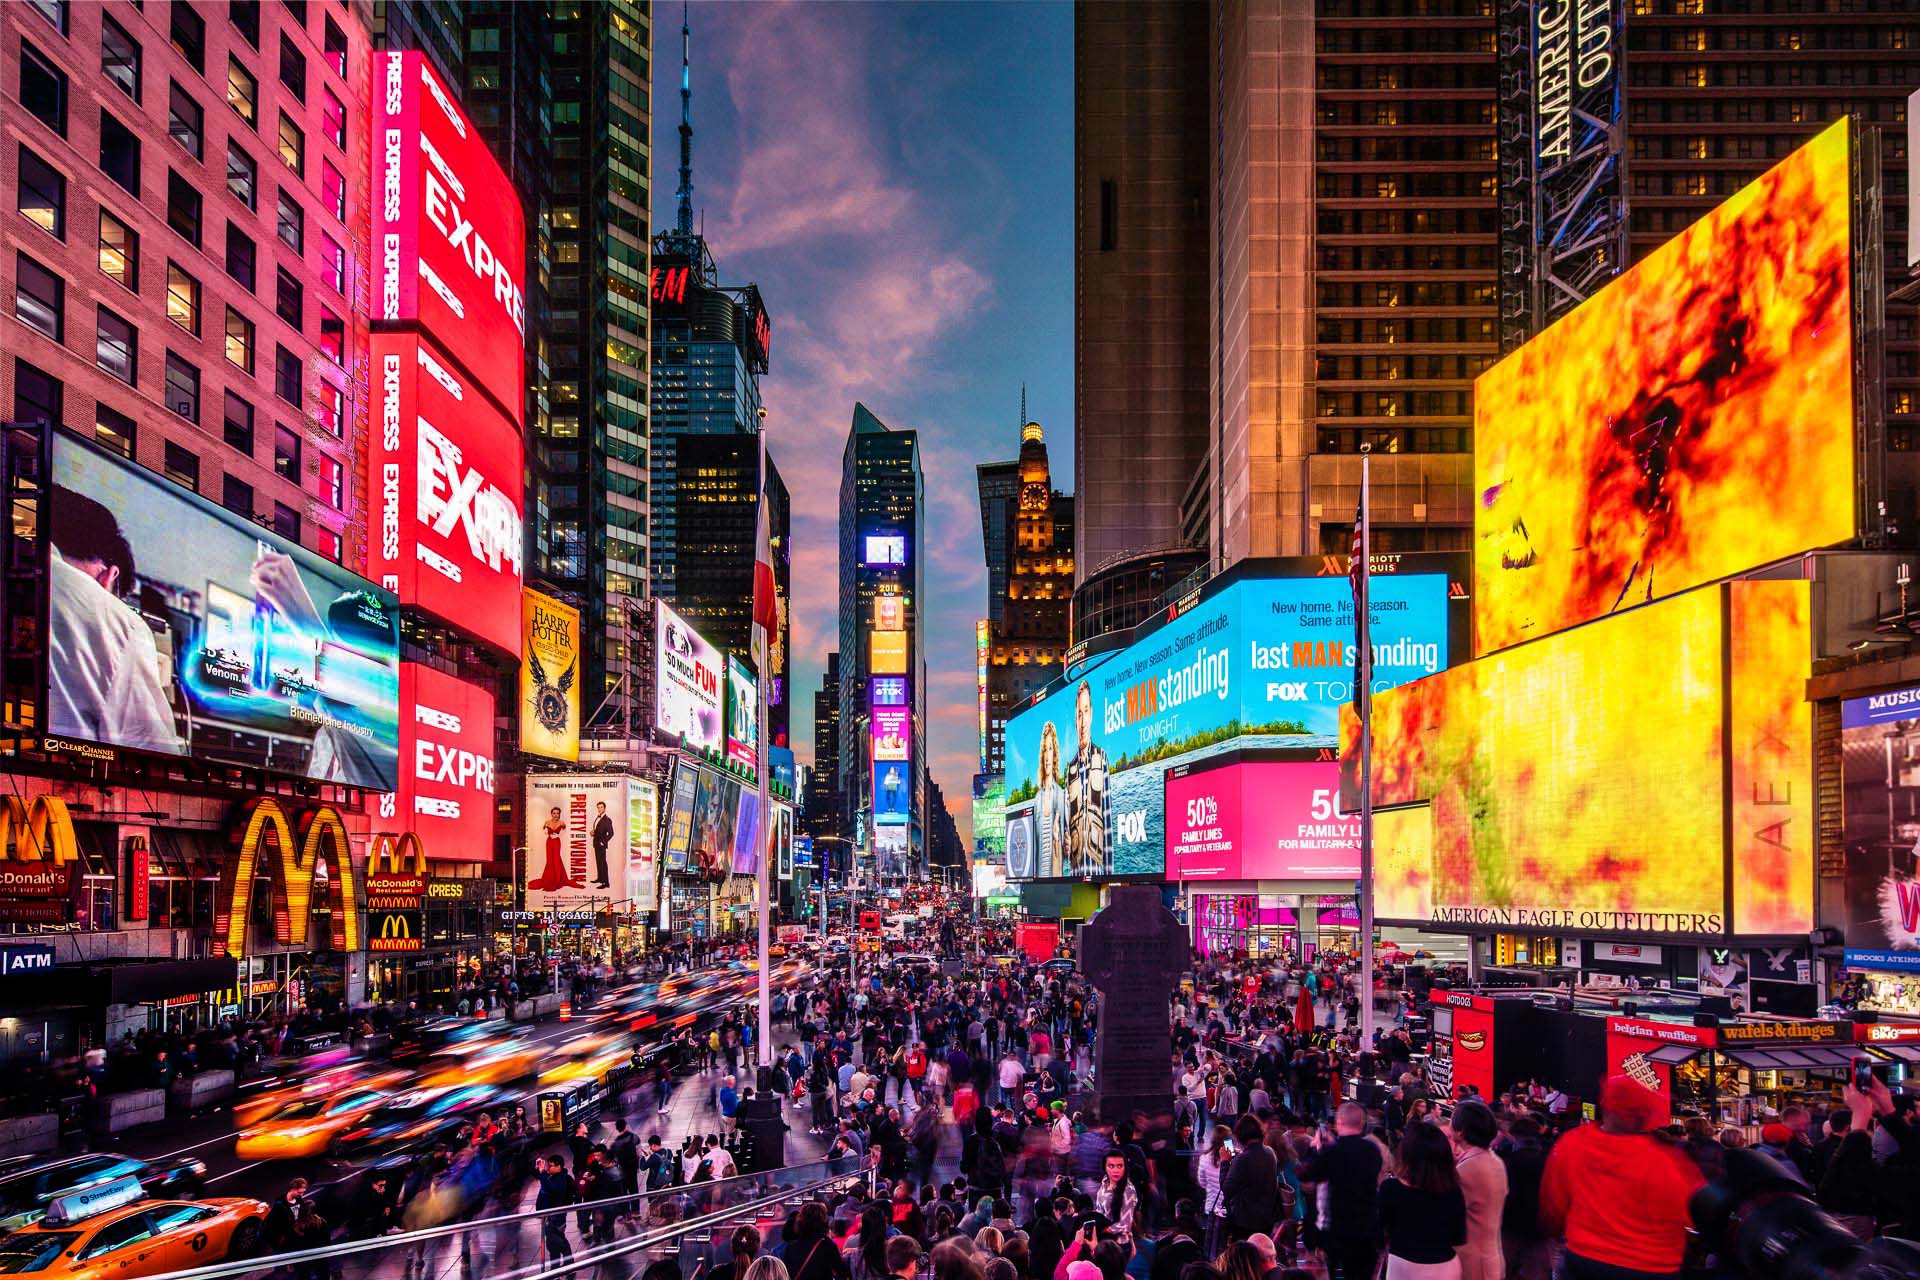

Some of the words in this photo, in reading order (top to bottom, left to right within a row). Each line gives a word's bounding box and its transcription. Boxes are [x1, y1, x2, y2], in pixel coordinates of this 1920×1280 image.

[384, 129, 402, 223] EXPRESS
[383, 354, 400, 452] EXPRESS
[382, 463, 400, 561] EXPRESS
[1272, 601, 1297, 614] New
[1300, 600, 1334, 613] home.
[1338, 600, 1354, 612] Ne
[533, 605, 571, 636] HARRY
[1299, 614, 1332, 627] Same
[1335, 613, 1381, 626] attide.
[531, 619, 573, 651] POTTER
[1251, 640, 1290, 670] last
[1292, 640, 1343, 669] MAN
[695, 660, 718, 698] FUN
[1104, 691, 1126, 736] last
[1126, 675, 1158, 727] MAN
[1158, 646, 1229, 713] standing
[1266, 682, 1309, 702] FOX
[1138, 713, 1179, 743] TONIGHT
[570, 793, 587, 833] PRETTY
[1206, 813, 1218, 826] OFF
[1117, 809, 1148, 845] FOX
[1181, 829, 1204, 844] FAMILY
[1203, 827, 1223, 841] LINES
[1297, 824, 1348, 838] FAMILY
[1278, 839, 1299, 849] FOR
[570, 839, 587, 883] WOMAN
[366, 879, 423, 889] McDonald's
[501, 911, 535, 920] GIFTS
[1430, 907, 1513, 926] AMERICAN
[1517, 909, 1575, 928] EAGLE
[1580, 911, 1722, 935] OUTFITTERS
[11, 953, 51, 969] ATM
[1614, 1022, 1654, 1037] belgian
[1657, 1029, 1697, 1042] waffles
[1724, 1023, 1836, 1041] wafels&dinges
[88, 1185, 125, 1201] StreetEasy
